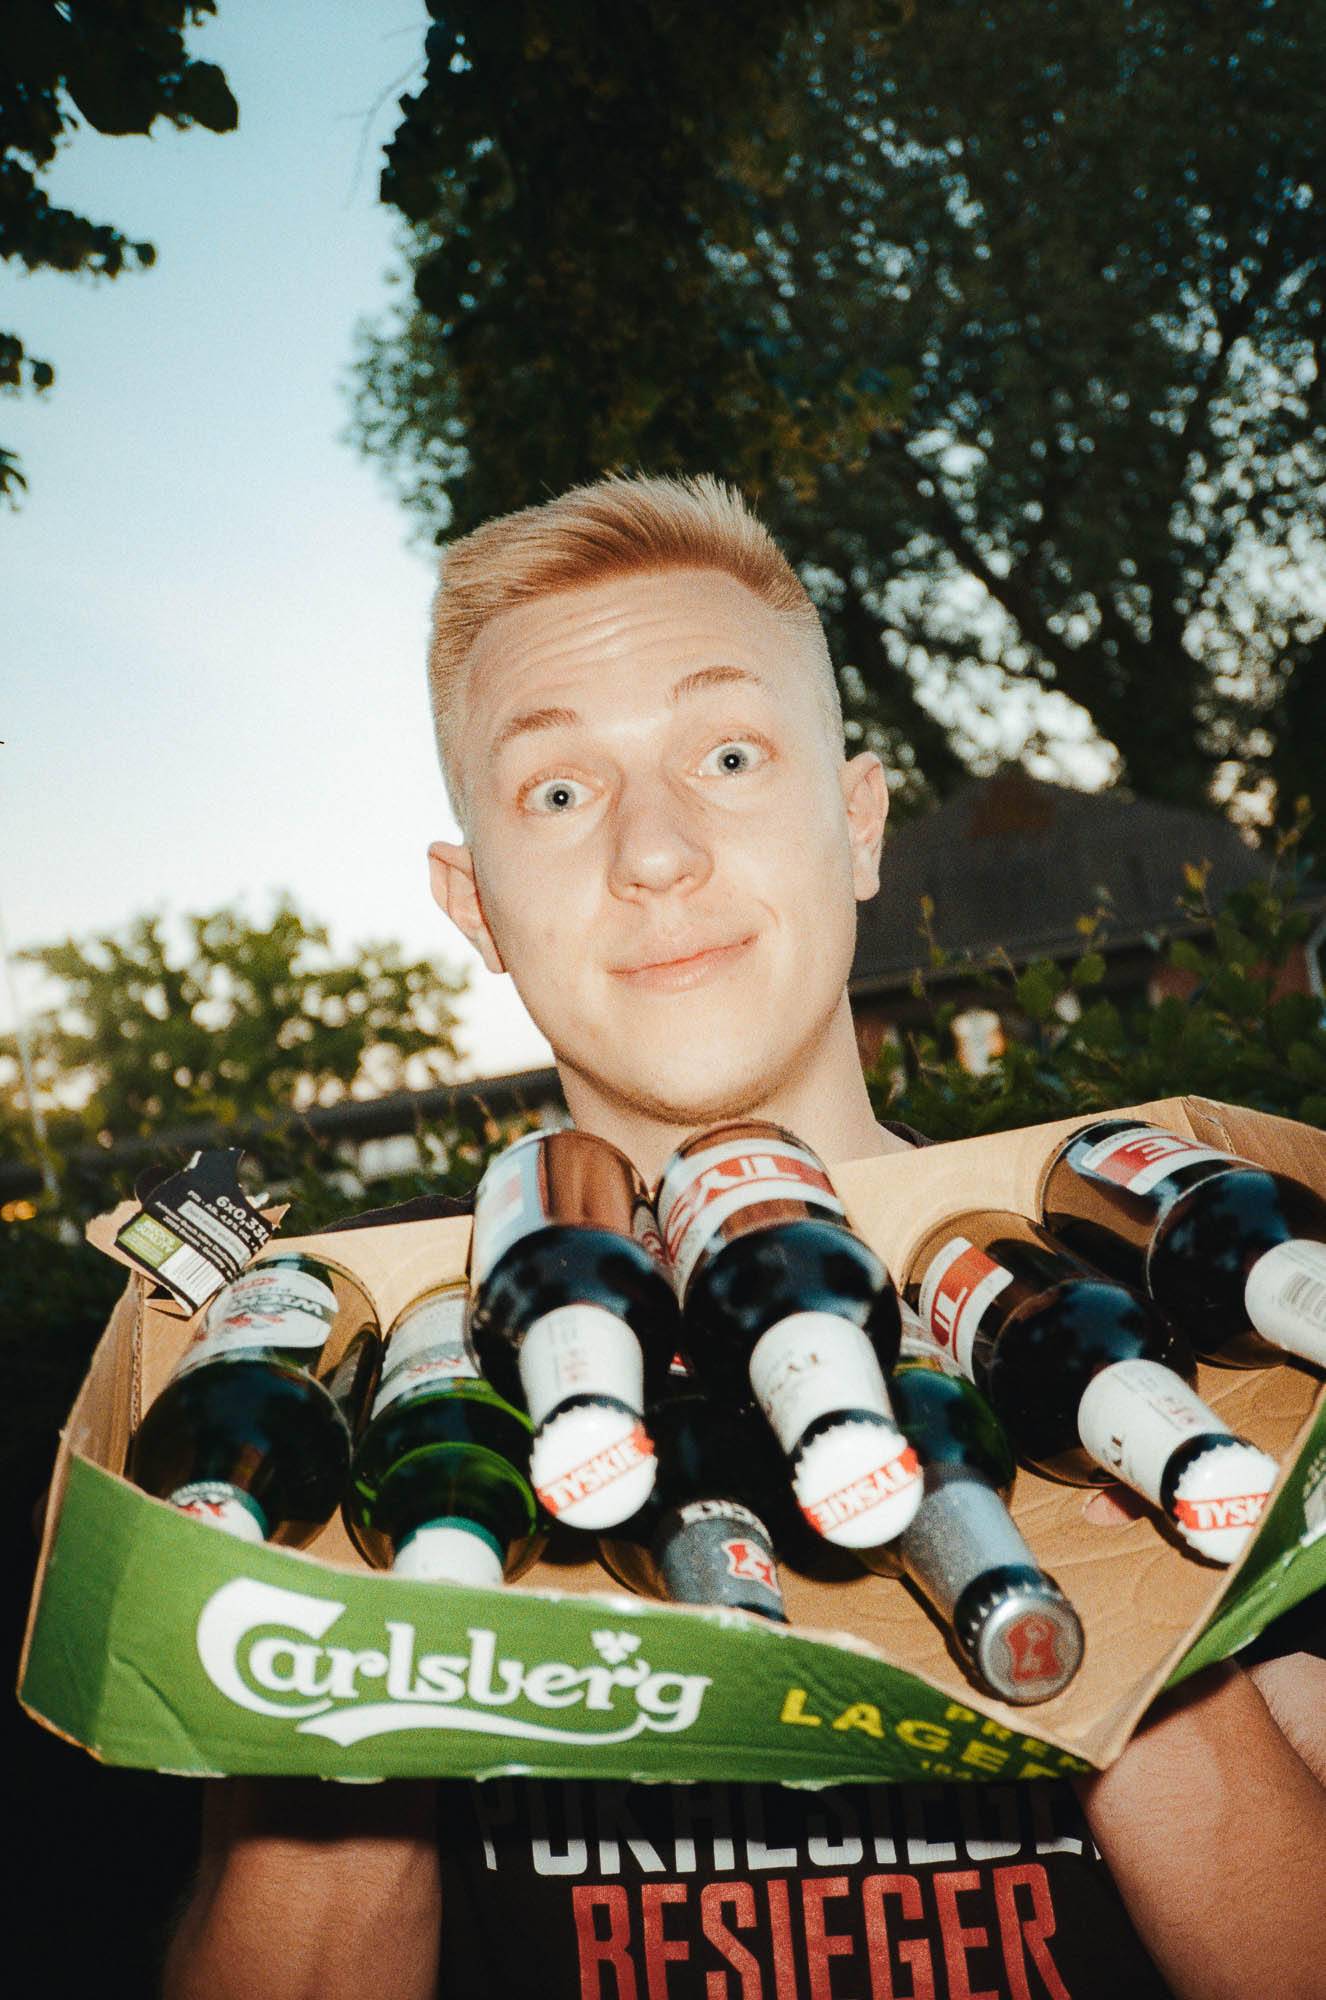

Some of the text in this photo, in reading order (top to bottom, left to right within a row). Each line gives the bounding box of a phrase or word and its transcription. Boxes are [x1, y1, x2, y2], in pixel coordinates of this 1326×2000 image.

[546, 1433, 648, 1510] TYSKIE
[810, 1456, 919, 1533] TYSKIE
[197, 1575, 712, 1748] Carlsberg
[571, 1863, 1072, 2000] BESIEGER
